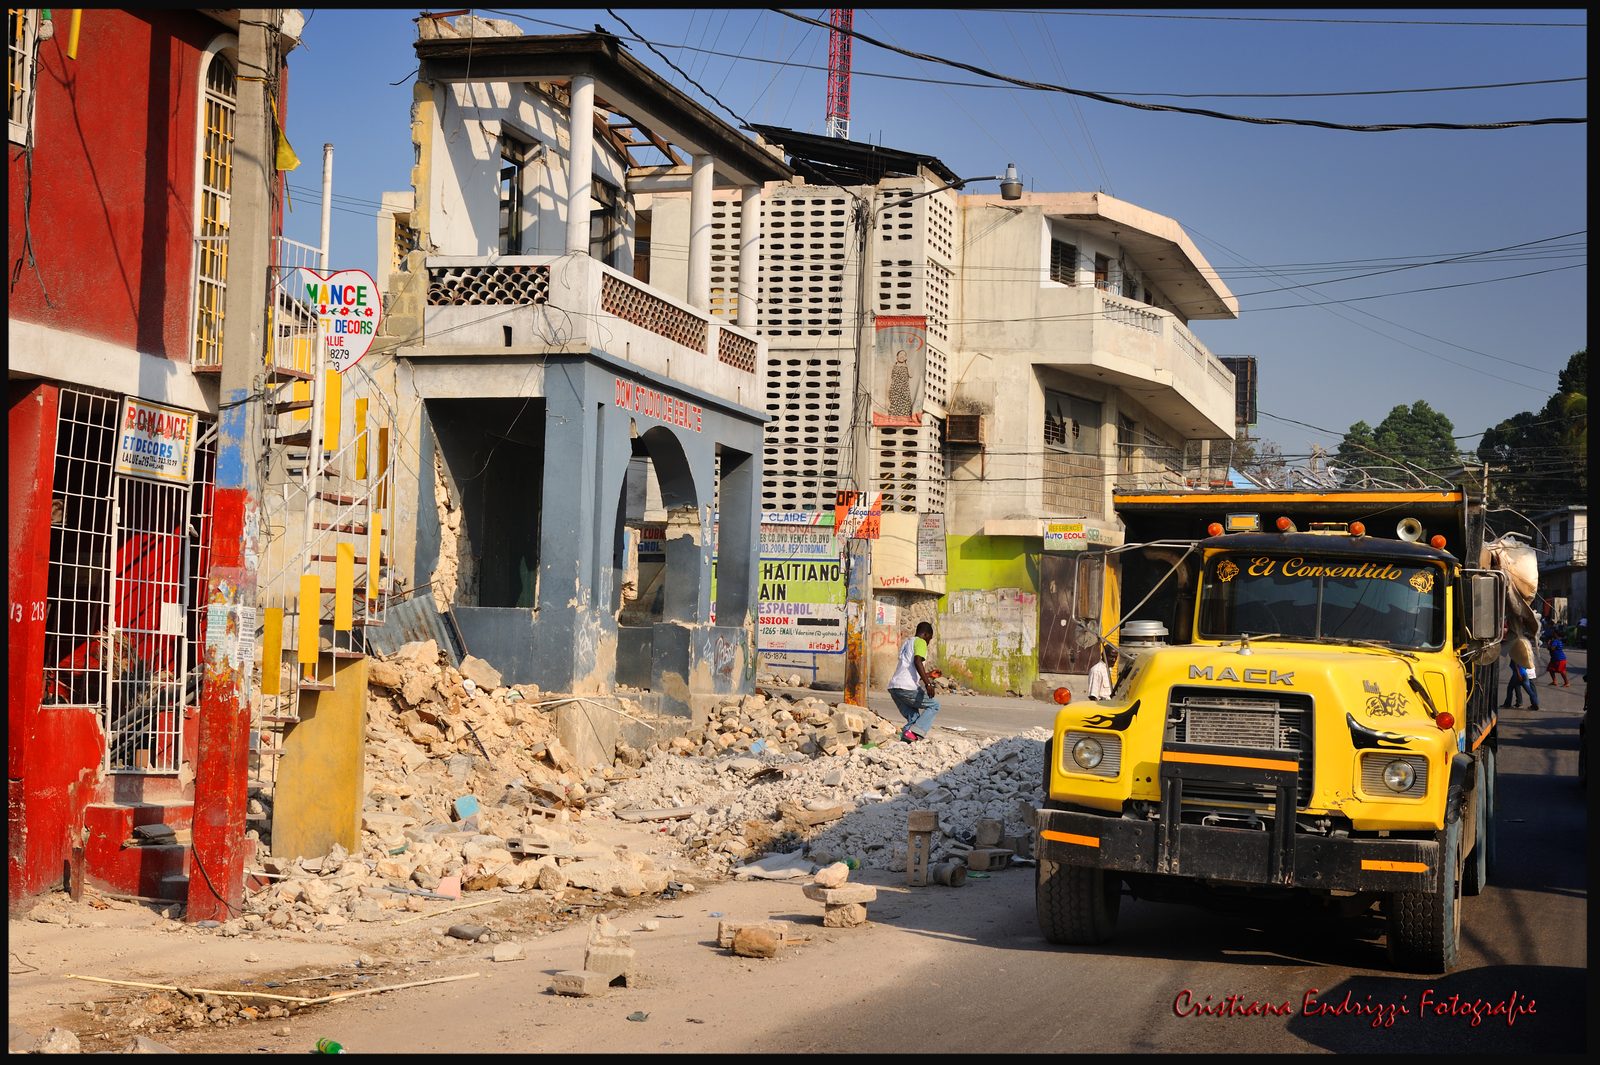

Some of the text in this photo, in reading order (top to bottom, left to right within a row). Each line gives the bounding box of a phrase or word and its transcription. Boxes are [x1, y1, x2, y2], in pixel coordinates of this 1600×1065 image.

[335, 319, 373, 335] DECORS
[662, 394, 673, 423] DE
[125, 406, 187, 441] ROMANCE
[837, 490, 867, 507] OPTI
[769, 512, 807, 522] CLAIRE
[1063, 532, 1087, 540] ECOLE
[763, 563, 840, 582] HAITIANO
[1248, 556, 1403, 581] El Consentido
[760, 583, 786, 601] AIN
[31, 601, 45, 622] 213
[758, 602, 813, 615] ESPAGNOL
[1188, 664, 1295, 685] MACK
